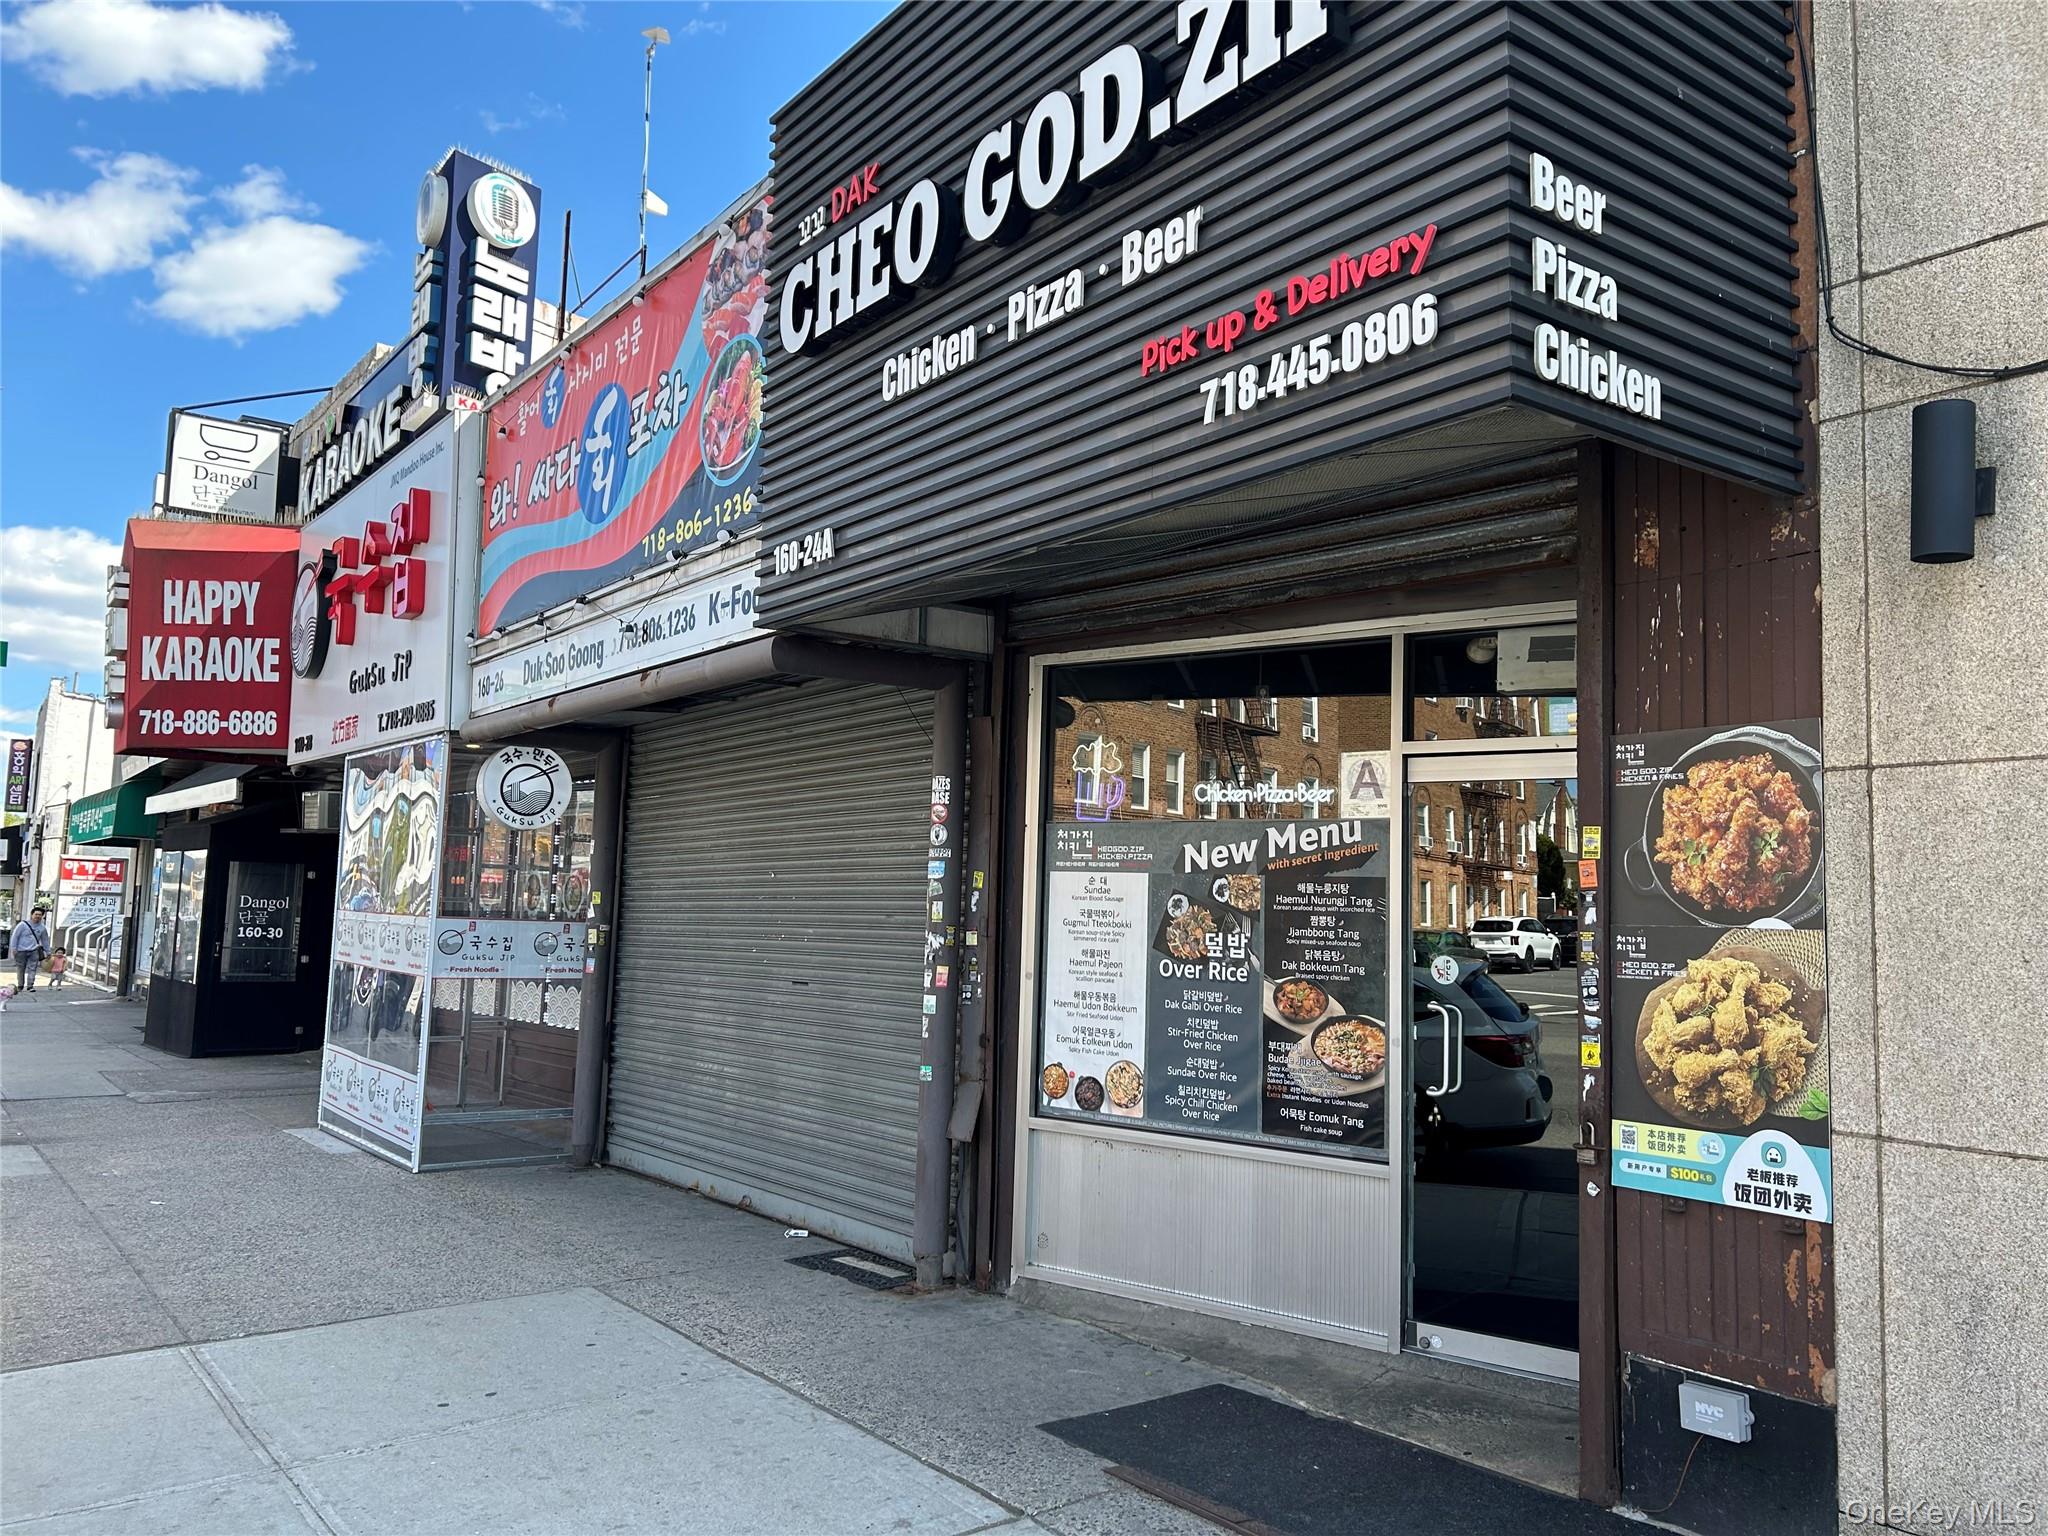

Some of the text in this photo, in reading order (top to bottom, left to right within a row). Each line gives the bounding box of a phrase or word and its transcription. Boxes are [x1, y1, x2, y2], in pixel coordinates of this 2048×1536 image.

[831, 161, 881, 223] DAK
[1530, 152, 1606, 235] Beer
[779, 178, 939, 353] CHEO
[1531, 236, 1618, 322] Pizza
[882, 205, 1203, 402] Chicken Pizza Beer
[1141, 223, 1438, 377] Pick up & Delivery
[615, 315, 643, 366] 전문
[1199, 293, 1439, 425] 718.445.0806
[1534, 322, 1662, 421] Chicken
[527, 436, 581, 507] 싸다
[626, 369, 689, 460] 포차
[297, 384, 403, 517] KARAOKE
[193, 465, 258, 491] Dangol
[192, 485, 230, 505] 단골
[191, 501, 217, 510] Korean
[642, 486, 752, 557] 718-806-1236
[774, 527, 835, 576] 160-24A
[163, 579, 261, 626] HAPPY
[141, 635, 280, 683] KARAOKE
[477, 670, 505, 699] 160-26
[523, 658, 543, 686] Duk
[544, 652, 565, 679] Soo
[568, 639, 605, 671] Goong
[349, 662, 386, 694] GukSu
[138, 709, 278, 736] 718-886-6886
[499, 747, 556, 767] 국수 만두
[1349, 759, 1384, 800] A
[496, 806, 534, 826] GukSu
[1183, 819, 1362, 874] New Menu
[1267, 842, 1379, 872] with secret ingredient
[1084, 885, 1112, 895] Sundae
[239, 895, 290, 912] Dangol
[1275, 894, 1373, 908] Haemul Nurungji Tang
[238, 910, 269, 925] 단골
[1062, 918, 1132, 929] Gugmul Tteokbokki
[237, 926, 284, 939] 160-30
[1287, 926, 1360, 940] Jjambbong Tang
[469, 936, 513, 952] 국수집
[461, 953, 494, 961] GukSu
[1069, 958, 1123, 970] Haemul Pajeon
[1159, 958, 1248, 982] Over Rice
[1281, 960, 1366, 976] Dak Bokkeum Tang
[1053, 999, 1138, 1014] Haemul Udon Bokkeum
[1164, 999, 1243, 1014] Dak Galbi Over Rice
[1056, 1034, 1133, 1050] Eomuk Eolkeun Udon
[1167, 1026, 1239, 1043] Stir-Fried Chicken
[1183, 1039, 1222, 1052] Over Rice
[1267, 1053, 1294, 1064] Budae
[1167, 1065, 1238, 1082] Sundae Over Rice
[1164, 1094, 1186, 1108] Spicy
[1206, 1100, 1238, 1113] Chicken
[1181, 1108, 1220, 1122] Over Rice
[1308, 1111, 1340, 1124] Eomuk
[1341, 1115, 1365, 1128] Tang
[1647, 1128, 1686, 1142] 本店推荐
[1647, 1140, 1687, 1156] 饭团外卖
[1746, 1167, 1799, 1188] 老板推荐
[1733, 1182, 1813, 1215] 饭团外卖
[1695, 1400, 1724, 1418] NYC
